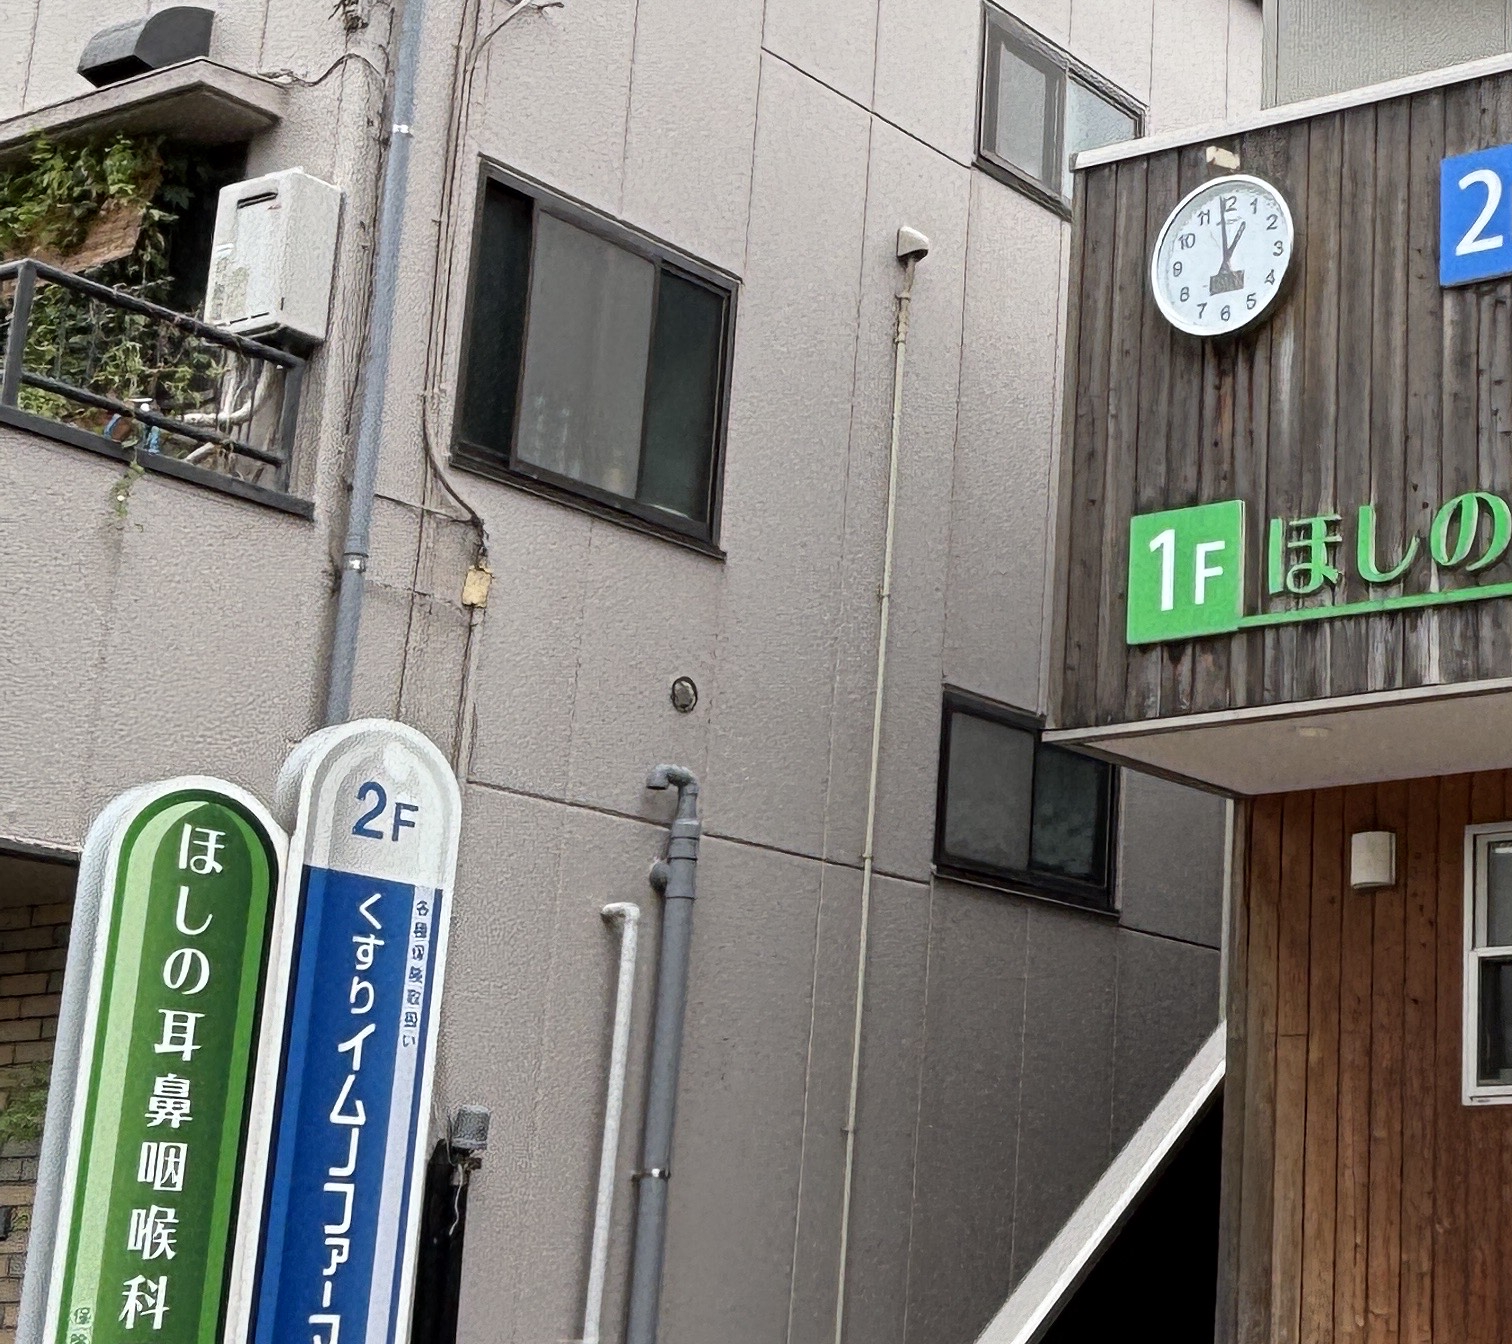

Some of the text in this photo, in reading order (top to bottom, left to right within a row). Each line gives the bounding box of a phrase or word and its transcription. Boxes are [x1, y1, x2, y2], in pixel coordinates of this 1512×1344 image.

[1250, 198, 1258, 214] 1
[1266, 214, 1278, 230] 2
[1178, 233, 1195, 250] 10
[1272, 241, 1283, 256] 3
[1172, 261, 1182, 277] 9
[1265, 269, 1275, 285] 4
[1180, 287, 1190, 302] 8
[1246, 293, 1256, 309] 5
[1197, 303, 1207, 319] 7
[1221, 305, 1230, 321] 6
[1147, 527, 1227, 613] 1F
[351, 780, 420, 844] 2F
